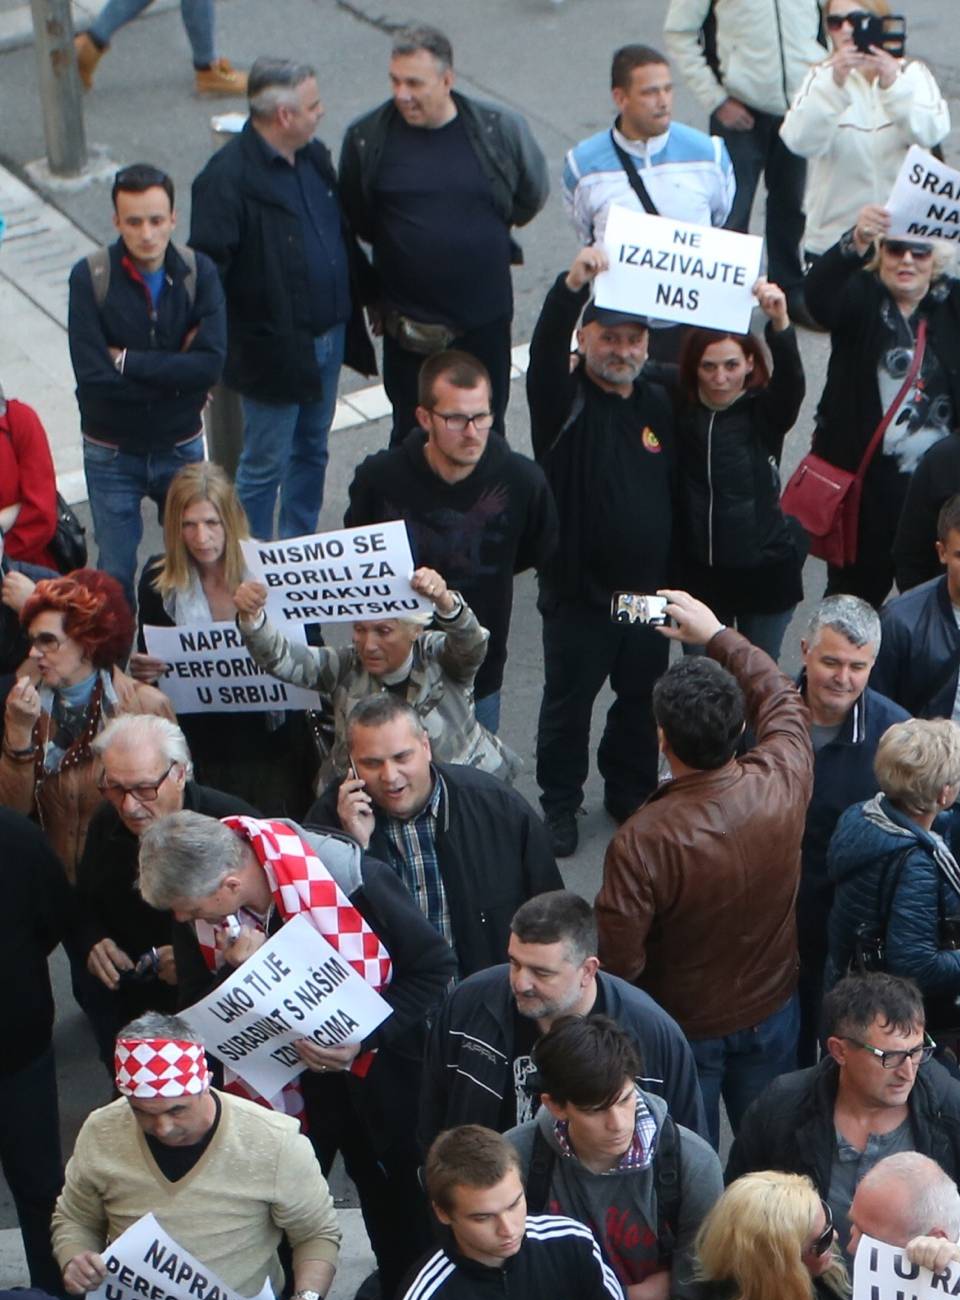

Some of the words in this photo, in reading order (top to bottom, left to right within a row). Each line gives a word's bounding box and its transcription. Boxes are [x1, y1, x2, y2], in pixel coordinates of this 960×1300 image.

[673, 229, 702, 249] NE
[618, 244, 748, 287] IZAZIVAJTE
[655, 283, 700, 311] NAS
[258, 539, 345, 565] NISMO
[352, 532, 387, 554] SE
[265, 566, 353, 588] BORILI
[359, 560, 395, 580] ZA
[285, 584, 391, 602] OVAKVU
[282, 598, 420, 620] HRVATSKU
[179, 628, 246, 652] NAPR
[164, 657, 266, 679] PERFORM
[197, 686, 213, 704] U
[218, 683, 288, 705] SRBIJI
[208, 986, 255, 1024] LAKO
[243, 969, 272, 997] TI
[262, 952, 291, 984] JE
[293, 956, 350, 1012] NAŠIM
[283, 999, 305, 1021] S
[869, 1247, 878, 1272] I
[893, 1254, 920, 1281] U
